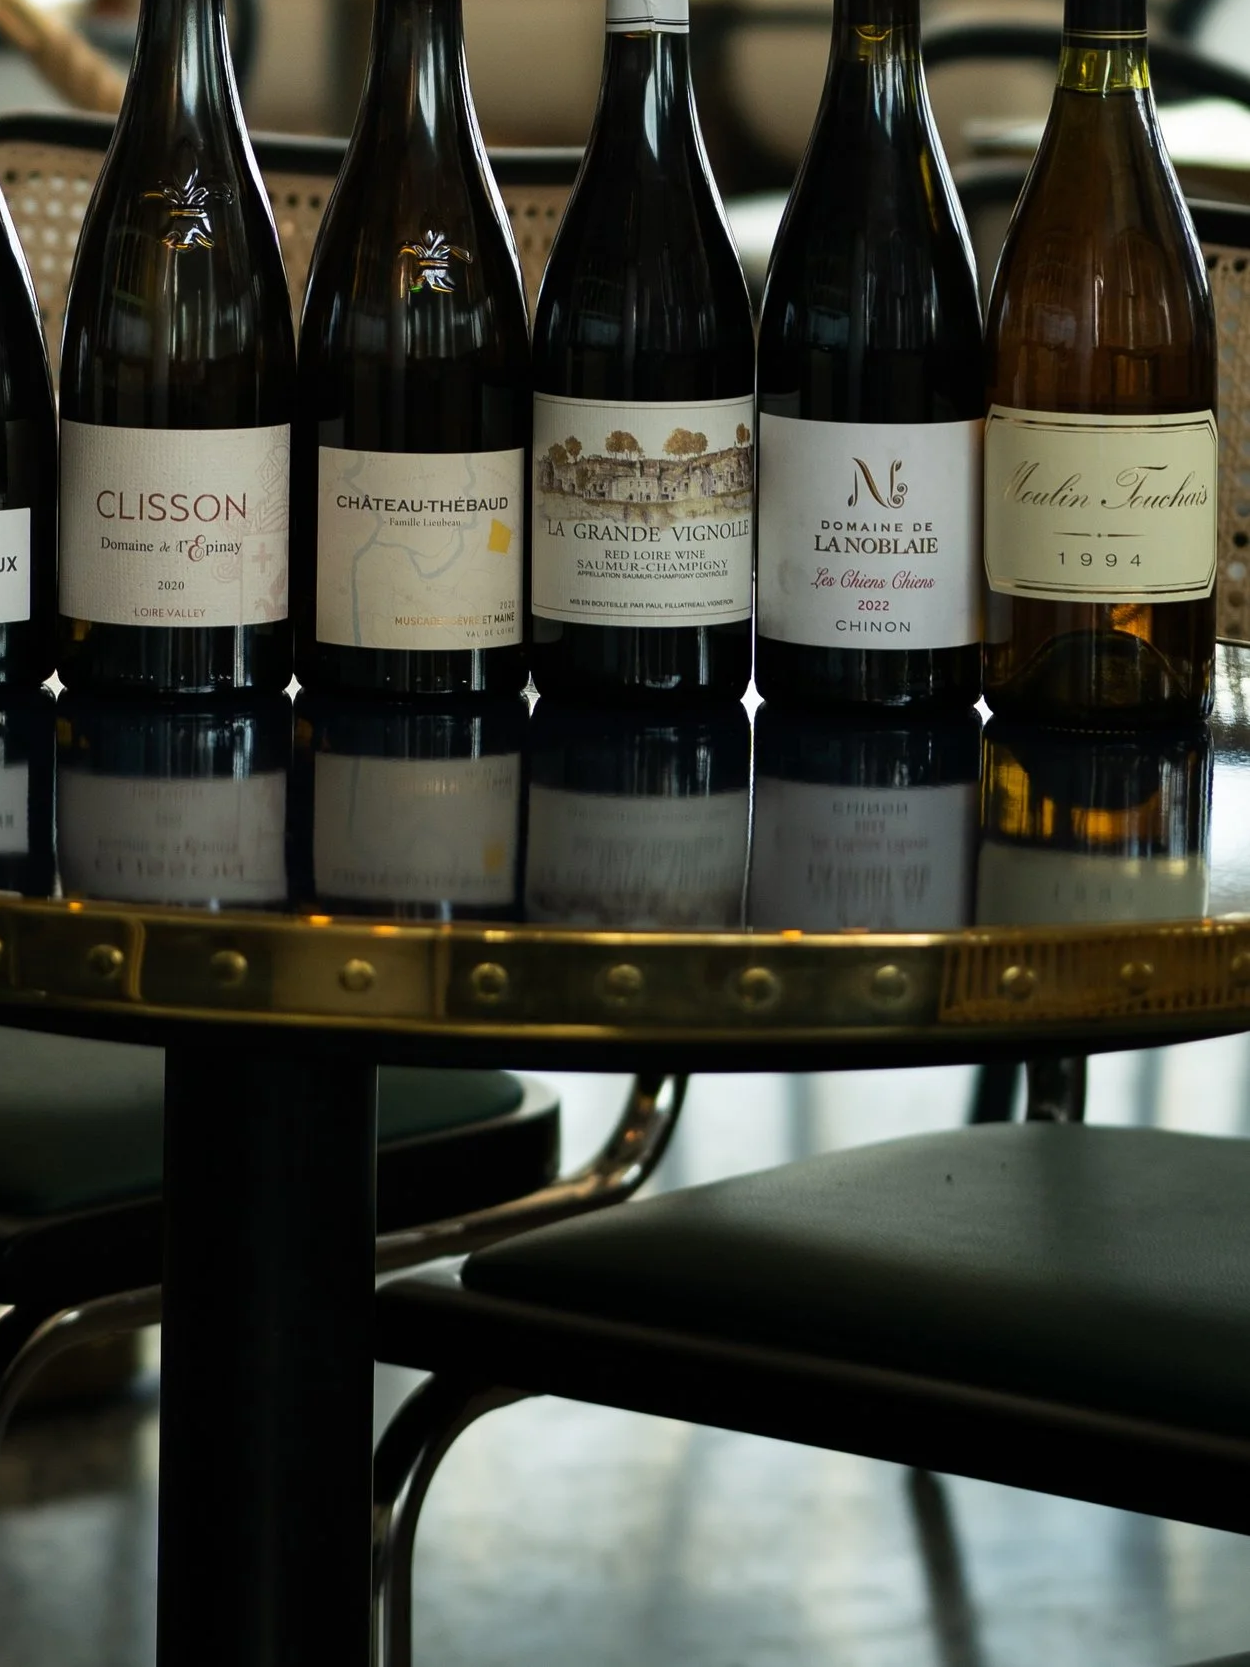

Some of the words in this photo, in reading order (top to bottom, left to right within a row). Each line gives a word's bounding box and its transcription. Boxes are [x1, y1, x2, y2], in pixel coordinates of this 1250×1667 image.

[1004, 460, 1090, 509] Moulin
[1100, 464, 1209, 510] Touchais
[96, 490, 247, 523] CLISSON
[336, 494, 509, 513] CHÂTEAU-THÉBAUD
[388, 517, 421, 527] Famille
[423, 517, 462, 528] Lieubeau
[821, 520, 903, 532] DOMAINE
[913, 522, 933, 532] DE
[547, 519, 565, 537] LA
[573, 522, 661, 543] GRANDE
[672, 519, 749, 542] VIGNOLLE
[100, 536, 154, 553] Domaine
[159, 541, 171, 553] de
[814, 534, 841, 553] LA
[844, 536, 939, 555] NOBLAIE
[604, 549, 630, 560] RED
[634, 550, 671, 561] LOIRE
[675, 549, 706, 560] WINE
[577, 559, 729, 573] SAUMUR-CHAMPIGNY
[577, 570, 621, 579] APPELLATION
[622, 571, 694, 580] SAUMUR-CHAMPIGNY
[695, 569, 729, 579] CONTRÔLÉE
[811, 567, 836, 589] Les
[840, 569, 887, 589] Chiens
[891, 570, 936, 590] Chiens
[157, 580, 185, 591] 2020
[591, 600, 629, 609] BOUTEILLE
[706, 598, 734, 607] VIGNERON
[857, 599, 890, 611] 2022
[134, 607, 165, 618] LOIRE
[166, 607, 206, 618] VALLEY
[394, 616, 448, 626] MUSCADE
[482, 614, 492, 625] ET
[494, 611, 516, 624] MAINE
[465, 630, 480, 638] VAL
[484, 629, 493, 637] DE
[497, 626, 515, 636] LOIRE
[835, 619, 911, 633] CHINON
